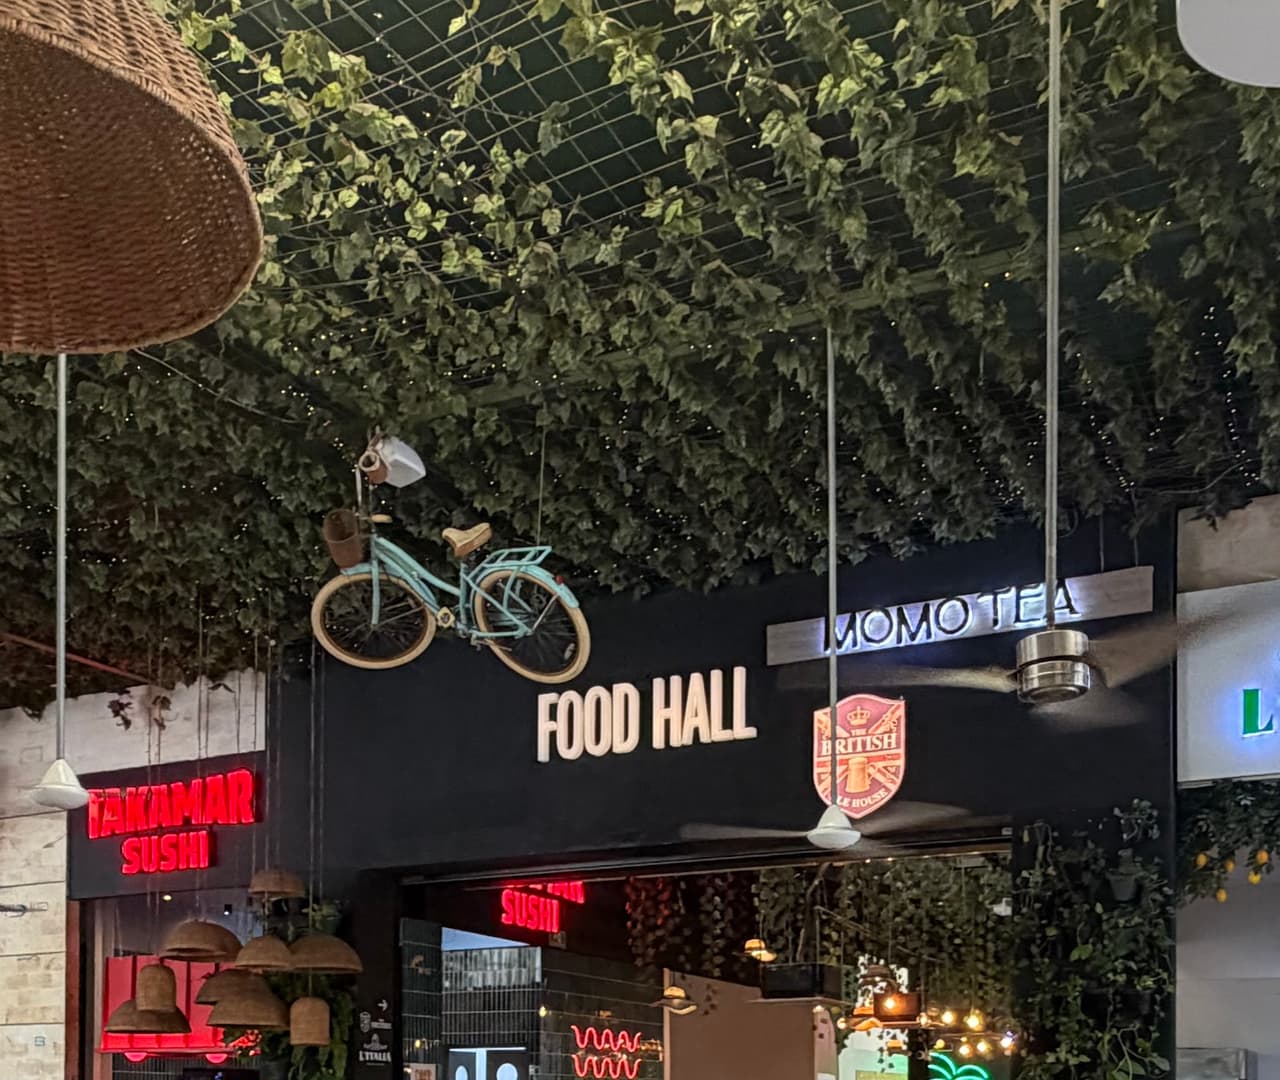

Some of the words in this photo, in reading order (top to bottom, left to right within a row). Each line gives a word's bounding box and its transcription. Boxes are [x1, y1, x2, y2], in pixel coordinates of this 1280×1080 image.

[537, 682, 640, 763] FOOD
[652, 666, 758, 749] HALL
[87, 769, 255, 839] TAKAMAR
[852, 788, 889, 808] HOUSE
[122, 830, 209, 874] SUSHI
[501, 889, 559, 933] SUSHI
